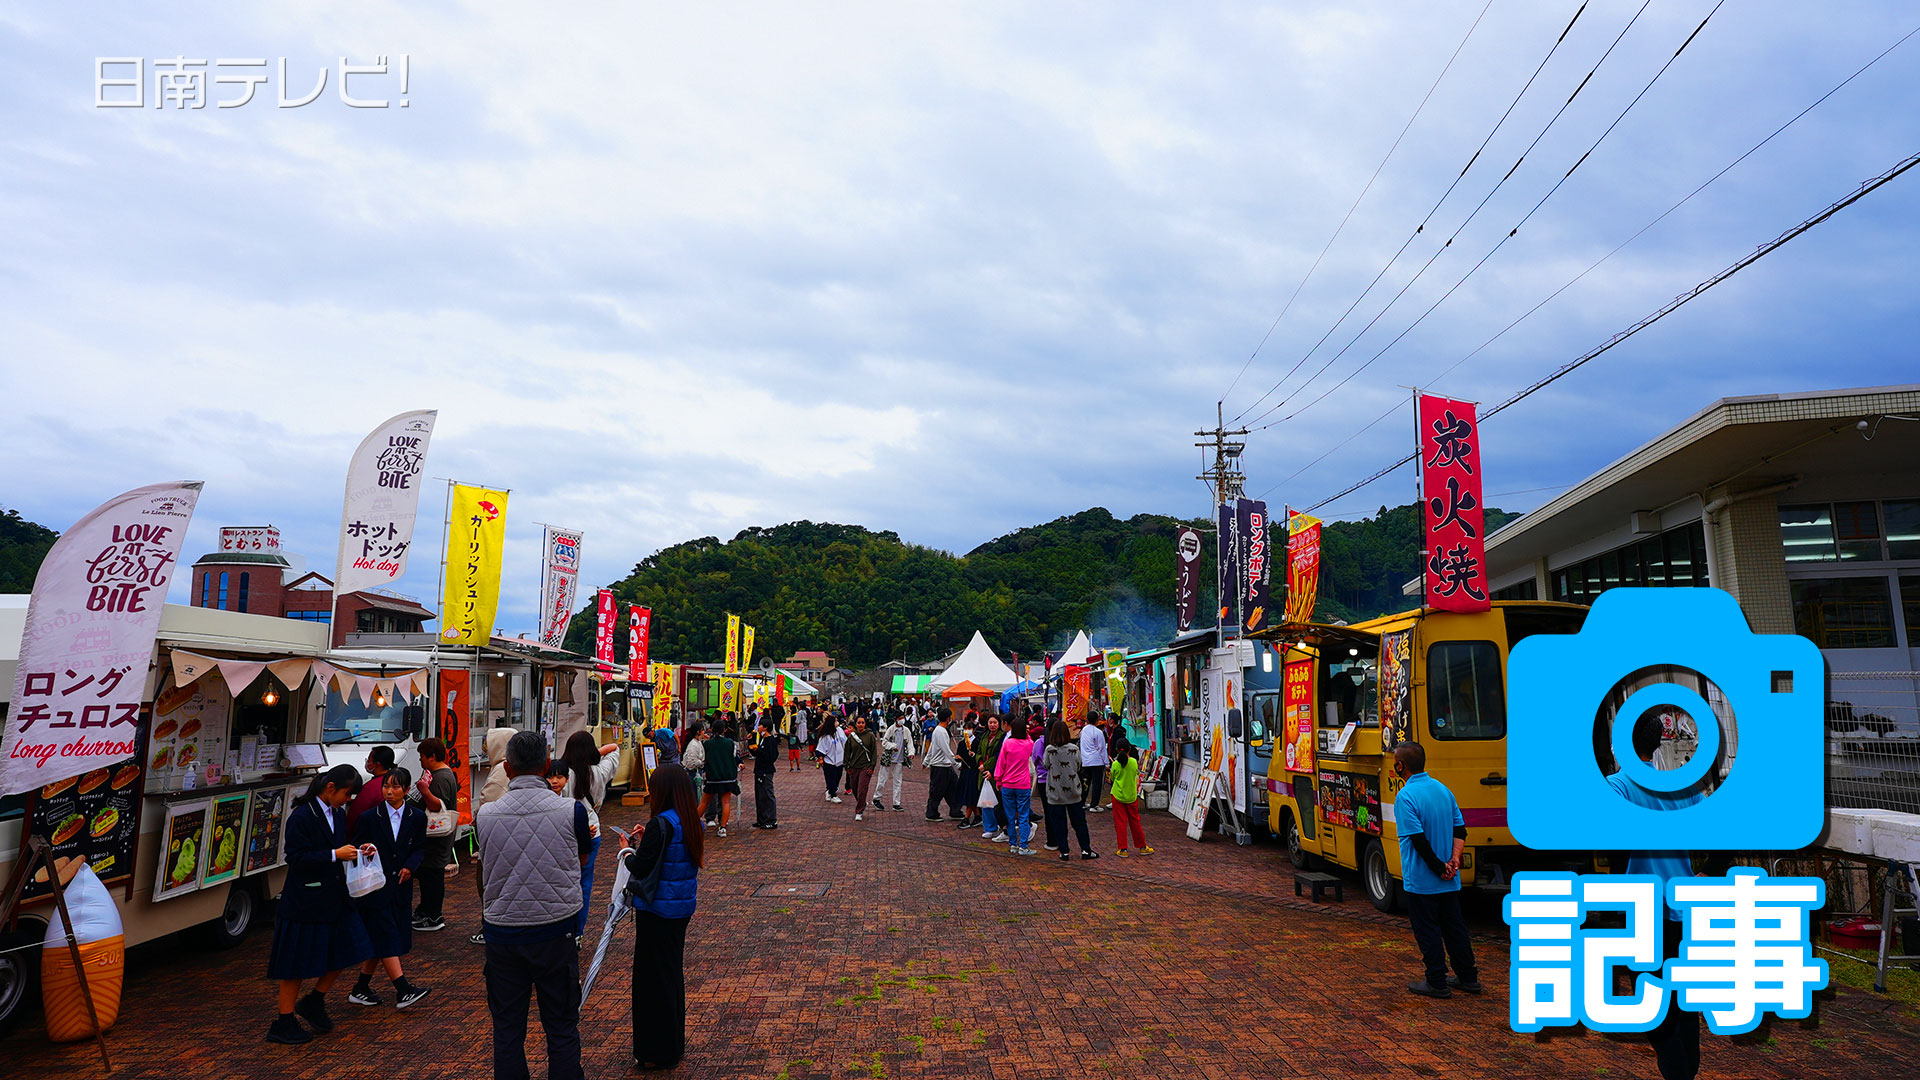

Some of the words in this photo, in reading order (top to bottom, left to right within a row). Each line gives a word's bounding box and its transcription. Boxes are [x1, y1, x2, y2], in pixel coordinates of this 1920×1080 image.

[389, 436, 421, 449] LOVE
[395, 447, 407, 455] AT
[376, 448, 423, 474] first
[378, 470, 412, 489] BITE
[1427, 410, 1486, 600] 炭火焼
[112, 524, 172, 545] LOVE
[223, 538, 262, 550] とむら
[347, 521, 398, 540] ホット
[122, 543, 145, 556] AT
[363, 539, 411, 560] ドッグ
[1248, 513, 1264, 601] ロングポテト
[85, 546, 174, 587] first
[353, 557, 376, 569] Hot
[377, 559, 399, 577] dog
[462, 515, 484, 639] ガーリックシュリンプ
[86, 583, 151, 613] BITE
[1181, 565, 1192, 628] うどん
[103, 651, 152, 667] Pierr
[23, 666, 132, 698] ロング
[1291, 685, 1307, 699] ポテト
[1396, 633, 1410, 742] 塩からあげ串
[659, 671, 672, 729] トルネー
[1066, 673, 1079, 721] チーズナン
[17, 704, 140, 734] チュロス
[10, 738, 57, 768] Long
[60, 735, 135, 757] churros
